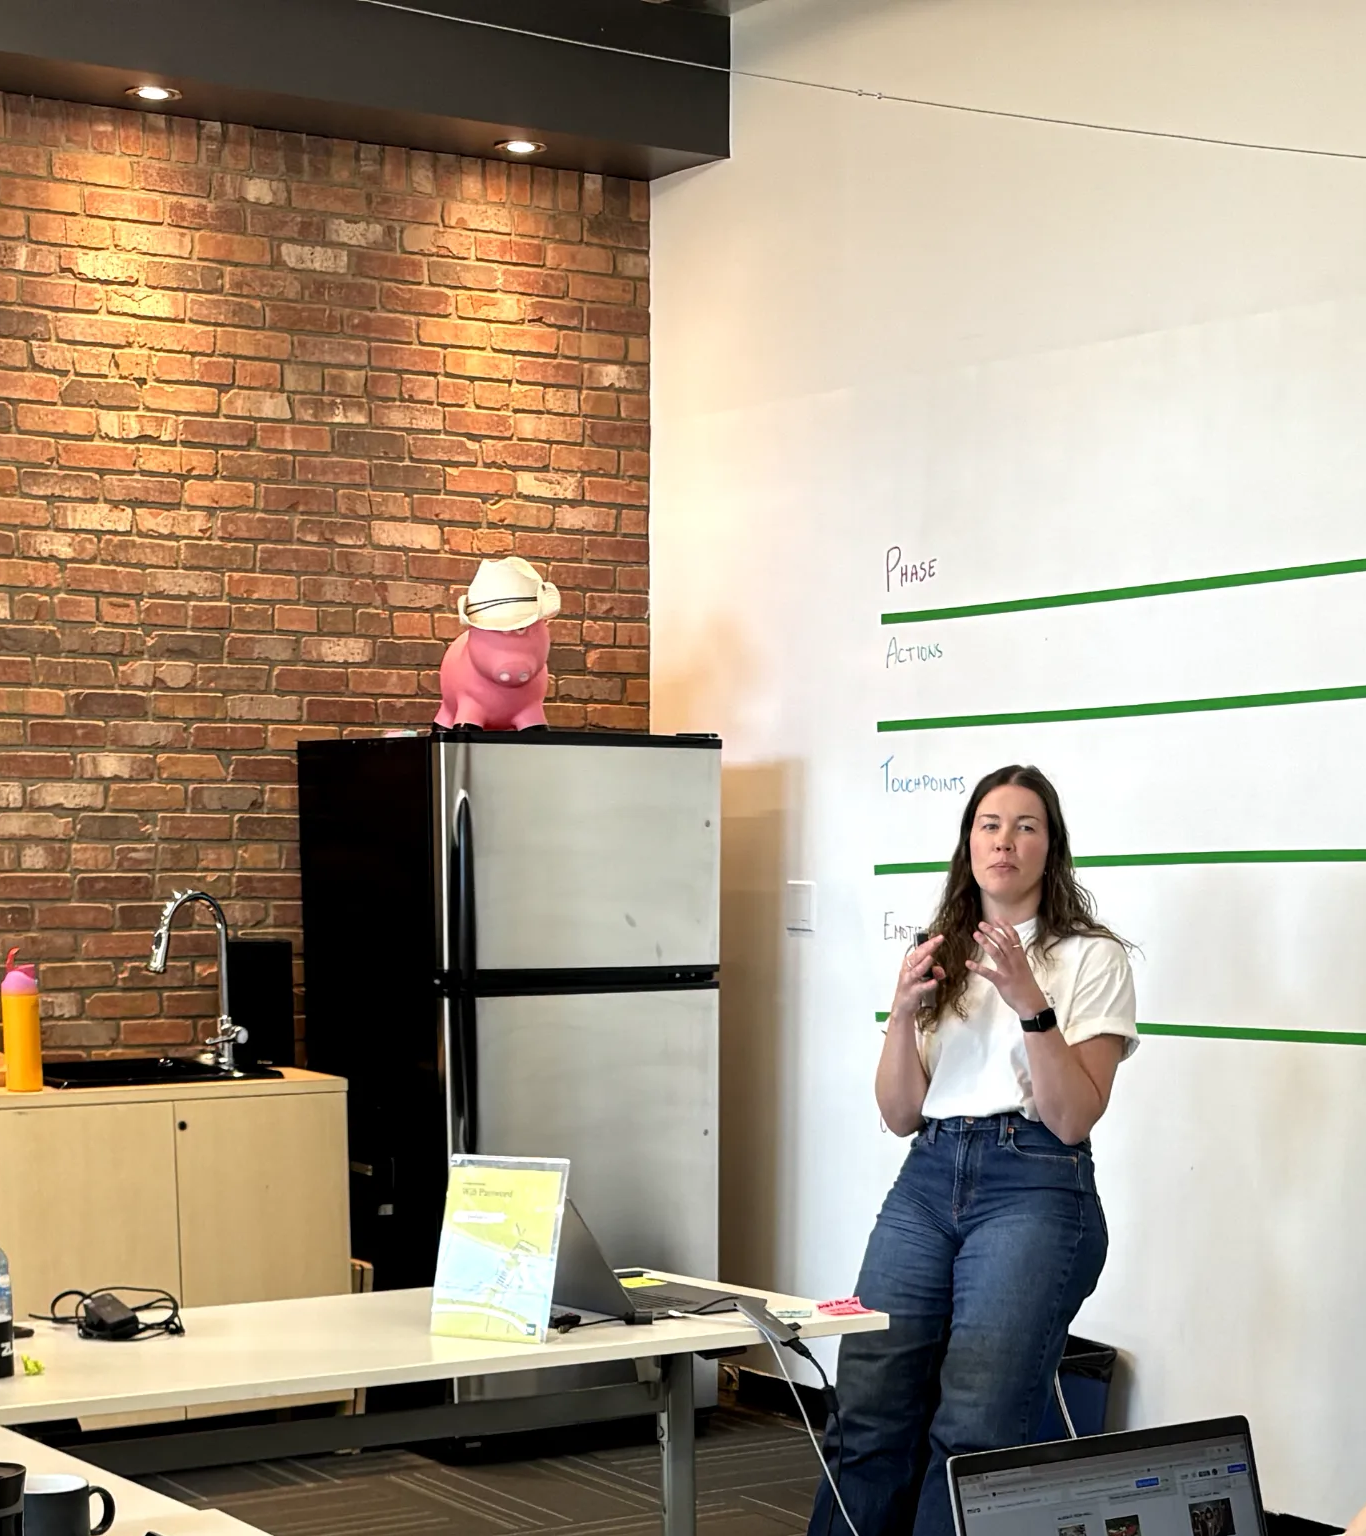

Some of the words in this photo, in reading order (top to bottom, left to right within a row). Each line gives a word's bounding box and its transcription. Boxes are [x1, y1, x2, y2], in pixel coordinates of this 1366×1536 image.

[885, 545, 938, 592] PHASE
[885, 636, 944, 669] ACTIONS
[880, 755, 966, 795] TOUCHPOINTS
